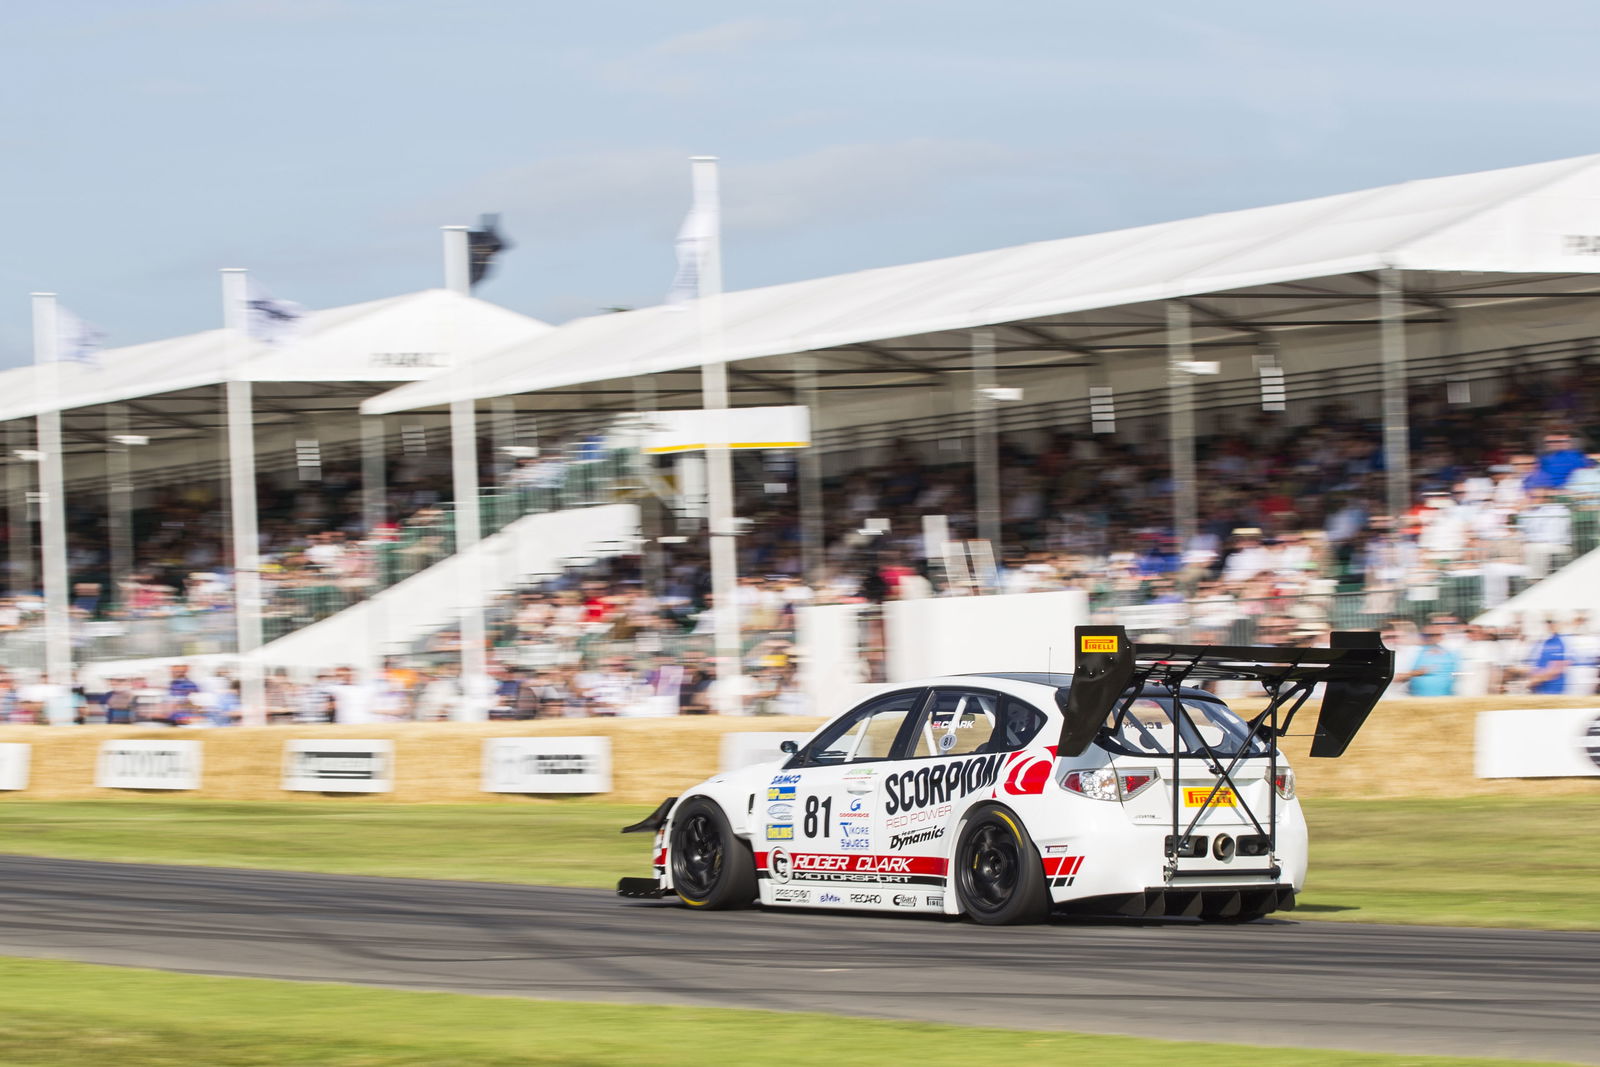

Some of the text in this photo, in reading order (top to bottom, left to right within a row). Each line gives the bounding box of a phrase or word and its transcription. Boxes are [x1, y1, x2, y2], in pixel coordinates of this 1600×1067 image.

[1084, 639, 1114, 650] PIRELLI
[943, 737, 953, 746] 81
[885, 753, 1007, 816] SCORPION
[804, 795, 832, 839] 81
[886, 805, 953, 830] RED POWER
[889, 825, 945, 851] Dynamics
[793, 855, 914, 873] ROGER CLARK
[794, 872, 912, 883] MOTORSPORT
[850, 893, 882, 904] RECARO
